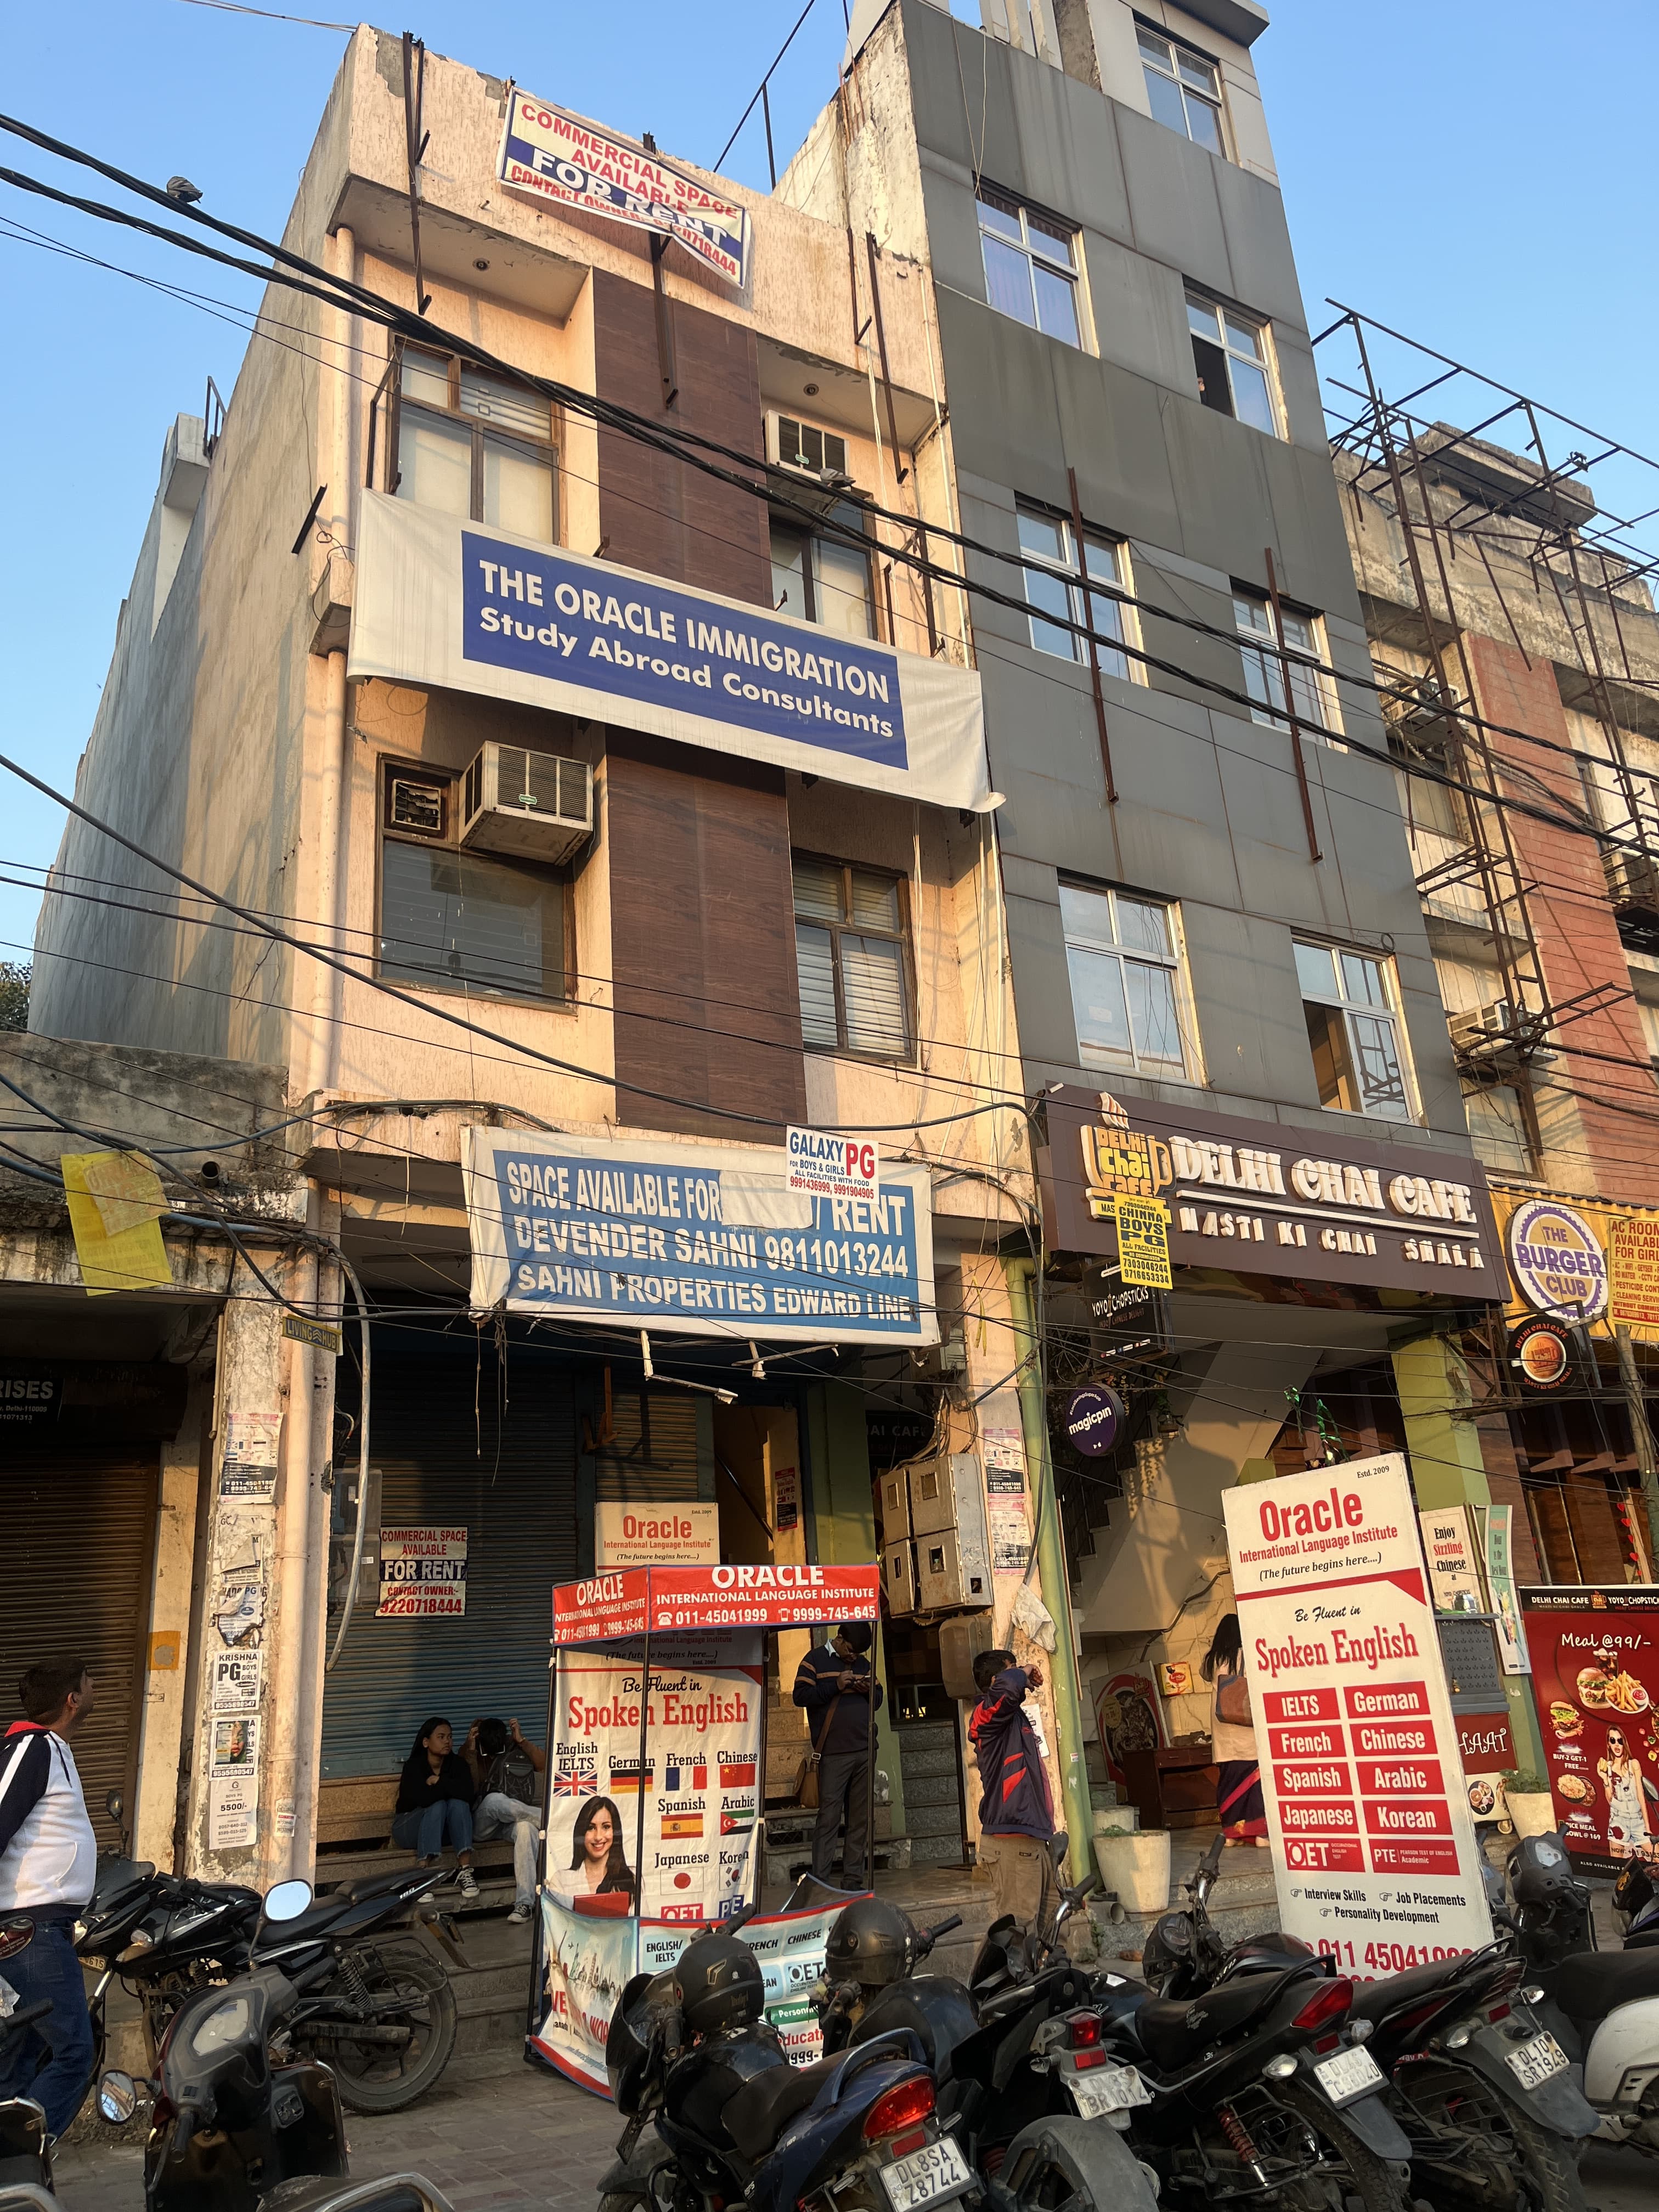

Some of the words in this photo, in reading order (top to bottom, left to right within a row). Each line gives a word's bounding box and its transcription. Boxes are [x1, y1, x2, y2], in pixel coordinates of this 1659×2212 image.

[522, 104, 667, 189] COMMERCIAL
[674, 180, 737, 219] SPACE
[511, 165, 582, 202] CONTACT
[532, 148, 612, 202] FOR
[624, 195, 727, 245] RENT
[479, 560, 543, 607] THE
[554, 583, 676, 644] ORACLE
[686, 619, 889, 703] IMMIGRATION
[479, 607, 578, 657] Study
[589, 636, 712, 689] Abroad
[723, 672, 893, 738] Consultants
[790, 1132, 844, 1162] GALAXY
[846, 1143, 874, 1179] PG
[800, 1159, 816, 1170] BOYS
[819, 1163, 823, 1172] &
[826, 1165, 844, 1175] GIRLS
[807, 1172, 836, 1182] FACILITIES
[1169, 1135, 1286, 1195] DELHI
[1291, 1158, 1386, 1210] CHAI
[1389, 1173, 1477, 1224] CAFE
[507, 1161, 571, 1210] SPACE
[576, 1169, 680, 1218] AVAILABLE
[686, 1177, 723, 1222] FOR
[831, 1192, 907, 1237] RENT
[834, 1184, 873, 1199] 9991904905
[1119, 1206, 1163, 1223] CHINNA
[1120, 1217, 1163, 1235] BOYS
[1542, 1226, 1568, 1243] THE
[1612, 1221, 1624, 1233] AC
[1178, 1206, 1265, 1242] MASTI
[1277, 1221, 1308, 1248] KI
[1321, 1228, 1376, 1256] CHAI
[1404, 1238, 1485, 1269] SHALA
[515, 1218, 668, 1262] DEVENDER
[674, 1227, 758, 1269] SAHNI
[765, 1235, 909, 1279] 9811013244
[1135, 1245, 1166, 1255] FACILITIES
[1616, 1247, 1634, 1259] FOR
[1124, 1258, 1168, 1274] 7303046244
[1516, 1243, 1606, 1278] BURGER
[1638, 1265, 1652, 1273] GEYSER
[1125, 1269, 1169, 1284] 9716653334
[517, 1262, 602, 1301] SAHNI
[609, 1272, 767, 1313] PROPERTIES
[772, 1286, 863, 1317] EDWARD
[1546, 1276, 1587, 1297] CLUB
[1616, 1282, 1644, 1291] PESTICIDE
[1616, 1292, 1641, 1301] CLEANING
[287, 1319, 312, 1340] LIVING
[323, 1330, 336, 1348] HUB
[1531, 1323, 1549, 1331] CHAI
[1069, 1407, 1111, 1435] magicpin
[1357, 1469, 1372, 1479] Estd.
[1373, 1465, 1390, 1476] 2009
[1260, 1487, 1363, 1542] Oracle
[623, 1515, 692, 1539] Oracle
[1434, 1527, 1455, 1539] Enjoy
[382, 1531, 437, 1542] COMMERCIAL
[441, 1531, 466, 1542] SPACE
[1239, 1540, 1299, 1563] International
[1301, 1534, 1350, 1554] Language
[1353, 1525, 1397, 1544] Institute
[402, 1544, 447, 1555] AVAILABLE
[1434, 1542, 1463, 1556] Sizzling
[385, 1560, 416, 1580] FOR
[421, 1561, 465, 1579] RENT
[1260, 1570, 1279, 1582] (The
[1282, 1564, 1310, 1579] future
[1312, 1560, 1344, 1572] begins
[1437, 1559, 1466, 1572] Chinese
[711, 1566, 824, 1589] ORACLE
[387, 1586, 421, 1596] CONTACT
[656, 1591, 752, 1605] INTERNATIONAL
[755, 1590, 817, 1601] LANGUAGE
[821, 1588, 874, 1599] INSTITUTE
[380, 1599, 461, 1613] 9220718444
[675, 1608, 767, 1624] 011-45041999
[793, 1605, 876, 1622] 9999-745-645
[1295, 1609, 1308, 1622] Be
[1312, 1606, 1346, 1622] Fluent
[1350, 1605, 1361, 1616] in
[1562, 1632, 1598, 1647] Meal
[1255, 1635, 1329, 1678] Spoken
[1331, 1622, 1419, 1669] English
[218, 1663, 241, 1681] PG
[623, 1677, 642, 1693] Be
[689, 1679, 702, 1690] in
[1282, 1695, 1319, 1717] IELTS
[1355, 1692, 1420, 1713] German
[663, 1693, 748, 1732] English
[1282, 1731, 1332, 1753] French
[1360, 1729, 1425, 1751] Chinese
[556, 1742, 598, 1757] English
[717, 1751, 757, 1764] Chinese
[558, 1758, 595, 1770] IELTS
[666, 1752, 706, 1766] French
[1283, 1768, 1341, 1792] Spanish
[1374, 1767, 1426, 1788] Arabic
[221, 1803, 247, 1812] 5500/-
[658, 1797, 706, 1812] Spanish
[721, 1796, 754, 1809] Arabic
[1283, 1807, 1353, 1829] Japanese
[1377, 1807, 1436, 1827] Korean
[654, 1852, 709, 1868] Japanese
[1374, 1849, 1397, 1863] PTE
[1305, 1888, 1341, 1901] Interview
[1344, 1890, 1366, 1901] Skills
[1396, 1892, 1411, 1904] Job
[1414, 1892, 1465, 1906] Placements
[1335, 1907, 1381, 1922] Personality
[1383, 1909, 1439, 1924] Development
[788, 1929, 822, 1944] CHINESE
[656, 1952, 675, 1963] IELTS
[895, 2145, 951, 2184] DL8SA
